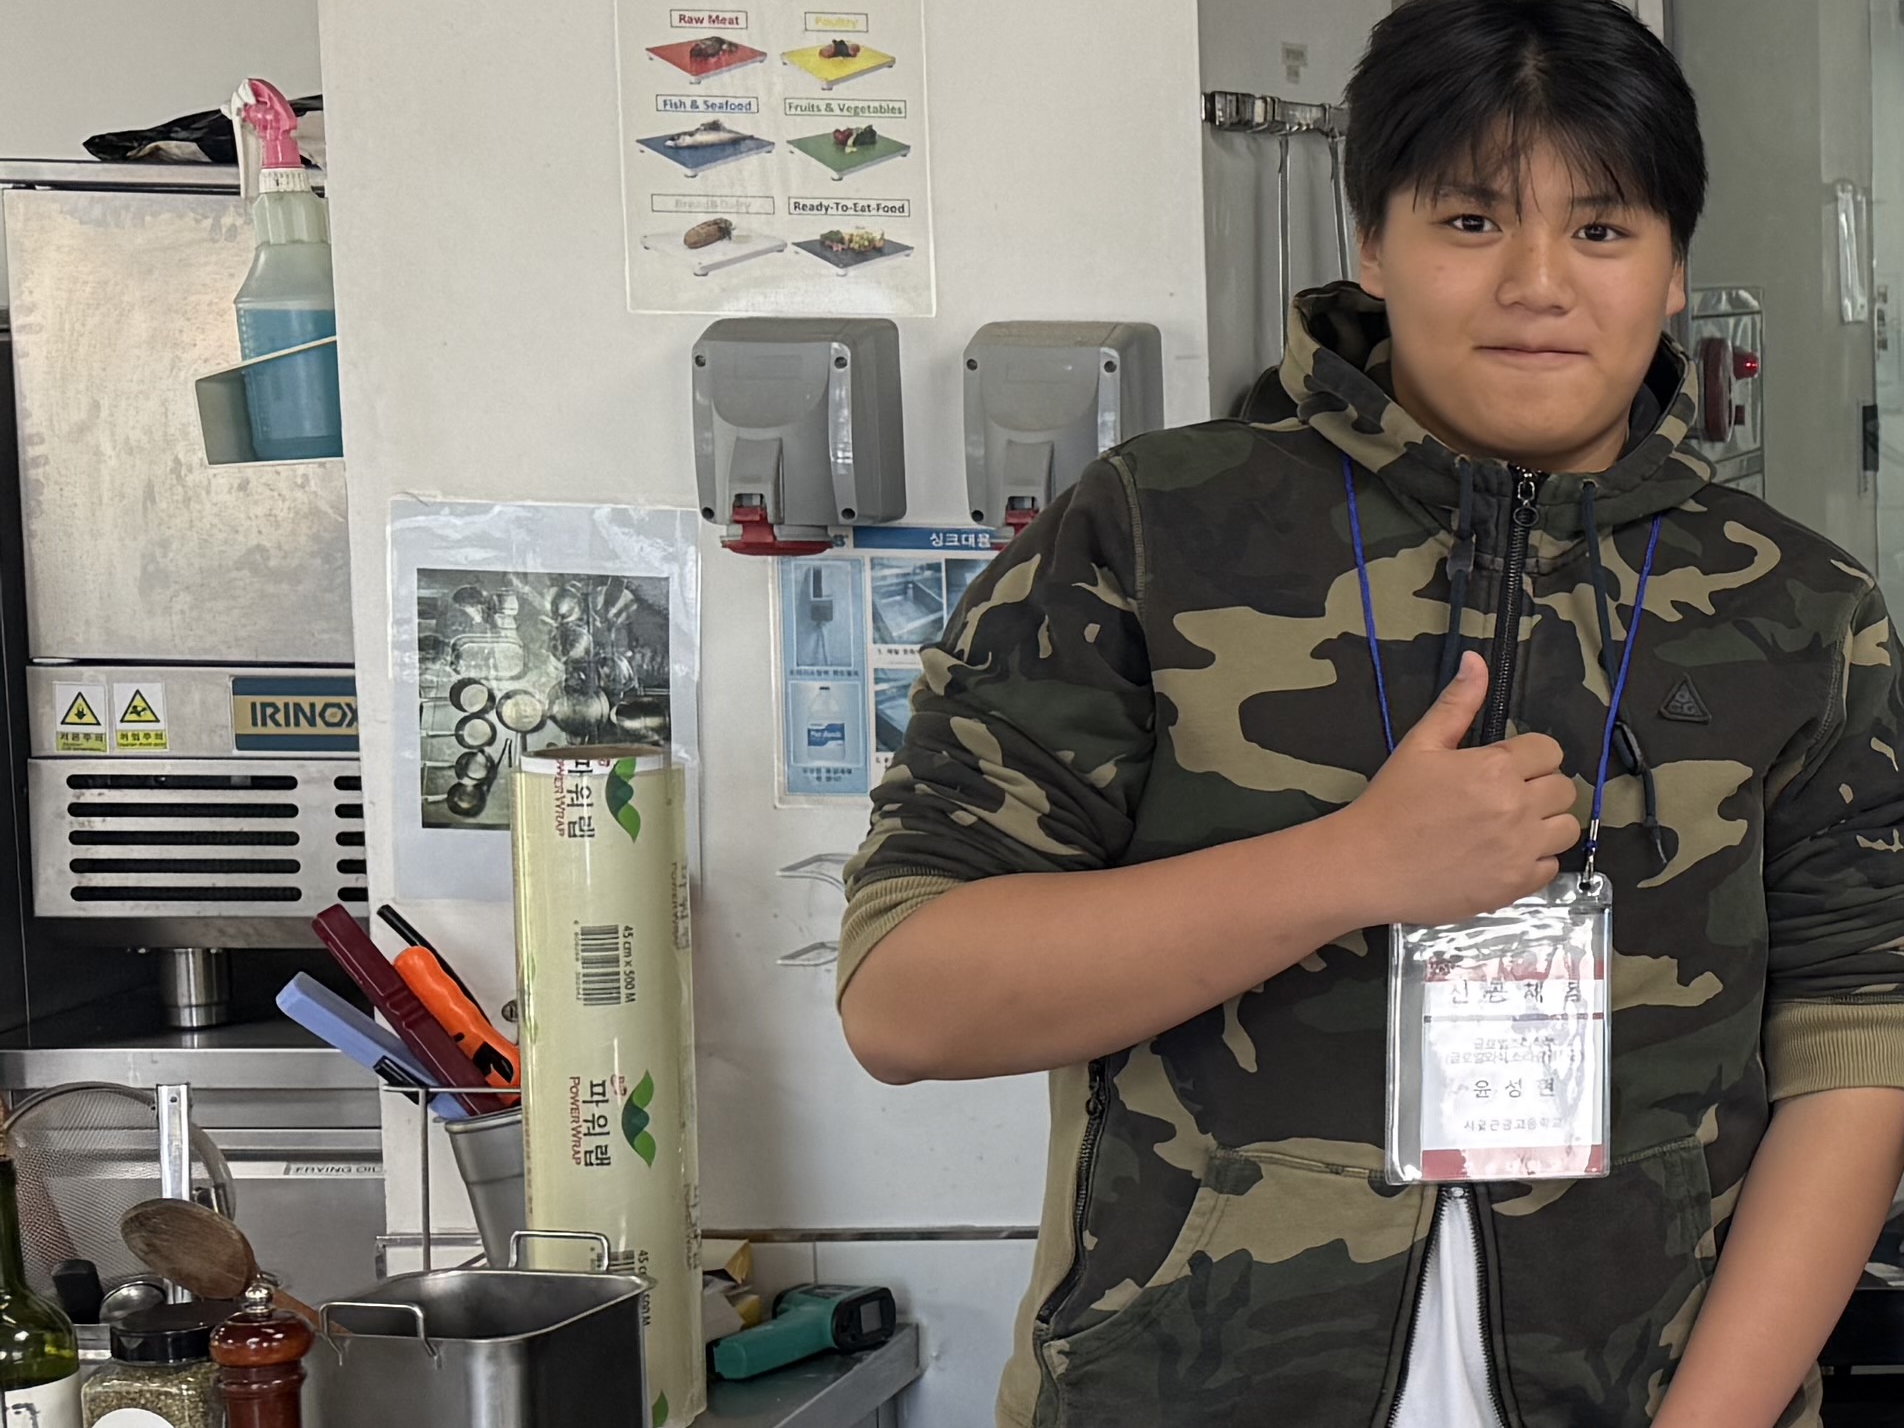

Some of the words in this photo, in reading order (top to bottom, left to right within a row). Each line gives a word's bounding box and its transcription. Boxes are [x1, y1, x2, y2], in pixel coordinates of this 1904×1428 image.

[678, 14, 705, 25] Raw
[708, 14, 740, 26] Meat
[662, 99, 687, 111] Fish
[690, 100, 700, 111] &
[703, 100, 752, 112] Seafood
[788, 102, 822, 113] Fruits
[825, 103, 834, 113] &
[837, 103, 903, 118] Vegetables
[793, 201, 905, 215] Ready-To-Eat-Food
[582, 1079, 611, 1167] 파워랩
